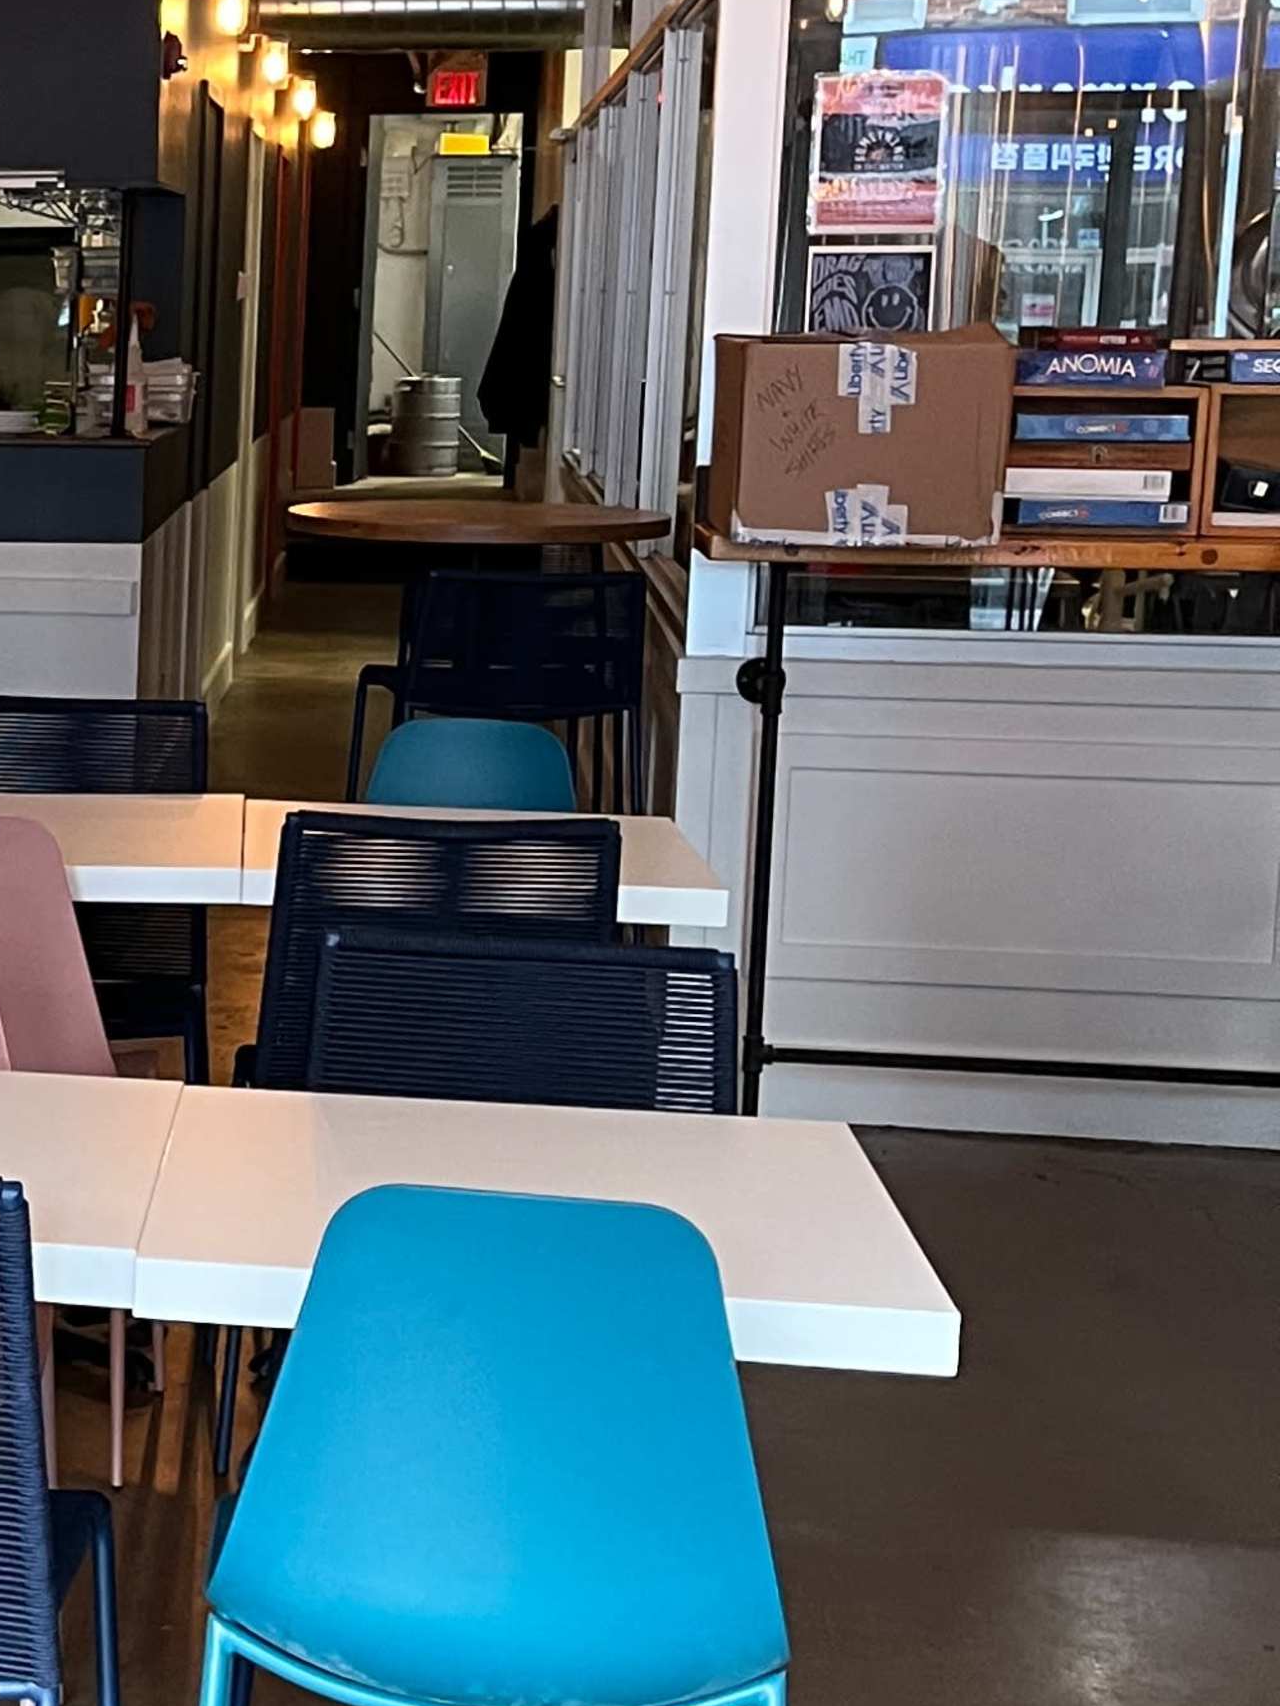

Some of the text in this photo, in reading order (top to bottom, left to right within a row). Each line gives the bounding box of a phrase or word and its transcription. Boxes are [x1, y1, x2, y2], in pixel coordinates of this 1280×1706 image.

[434, 71, 480, 105] EXIT
[812, 254, 867, 289] DRAG
[1044, 353, 1137, 379] ANOMIA
[756, 363, 803, 412] NAVY
